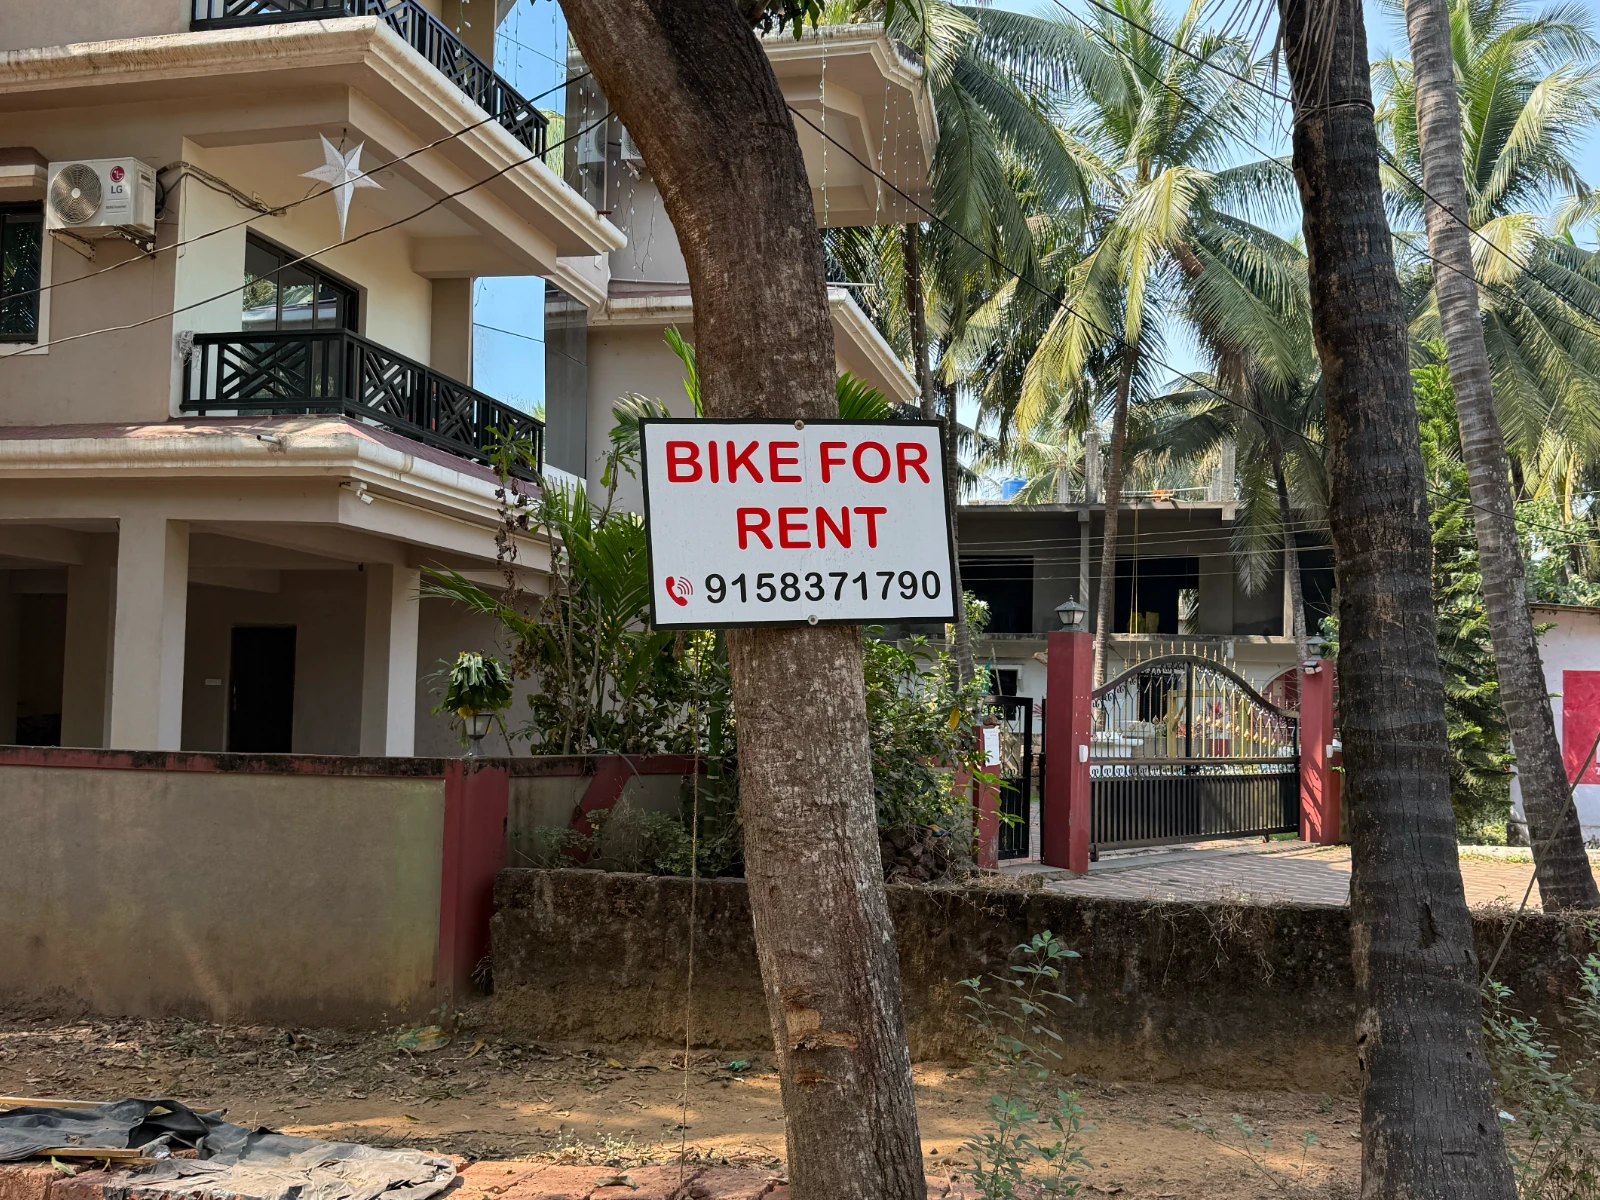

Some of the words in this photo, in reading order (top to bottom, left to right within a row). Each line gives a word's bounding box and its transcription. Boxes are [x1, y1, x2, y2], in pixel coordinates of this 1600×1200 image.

[111, 185, 124, 195] LG
[666, 441, 802, 483] BIKE
[820, 442, 930, 483] FOR
[737, 506, 887, 550] RENT
[705, 570, 941, 603] 9158371790
